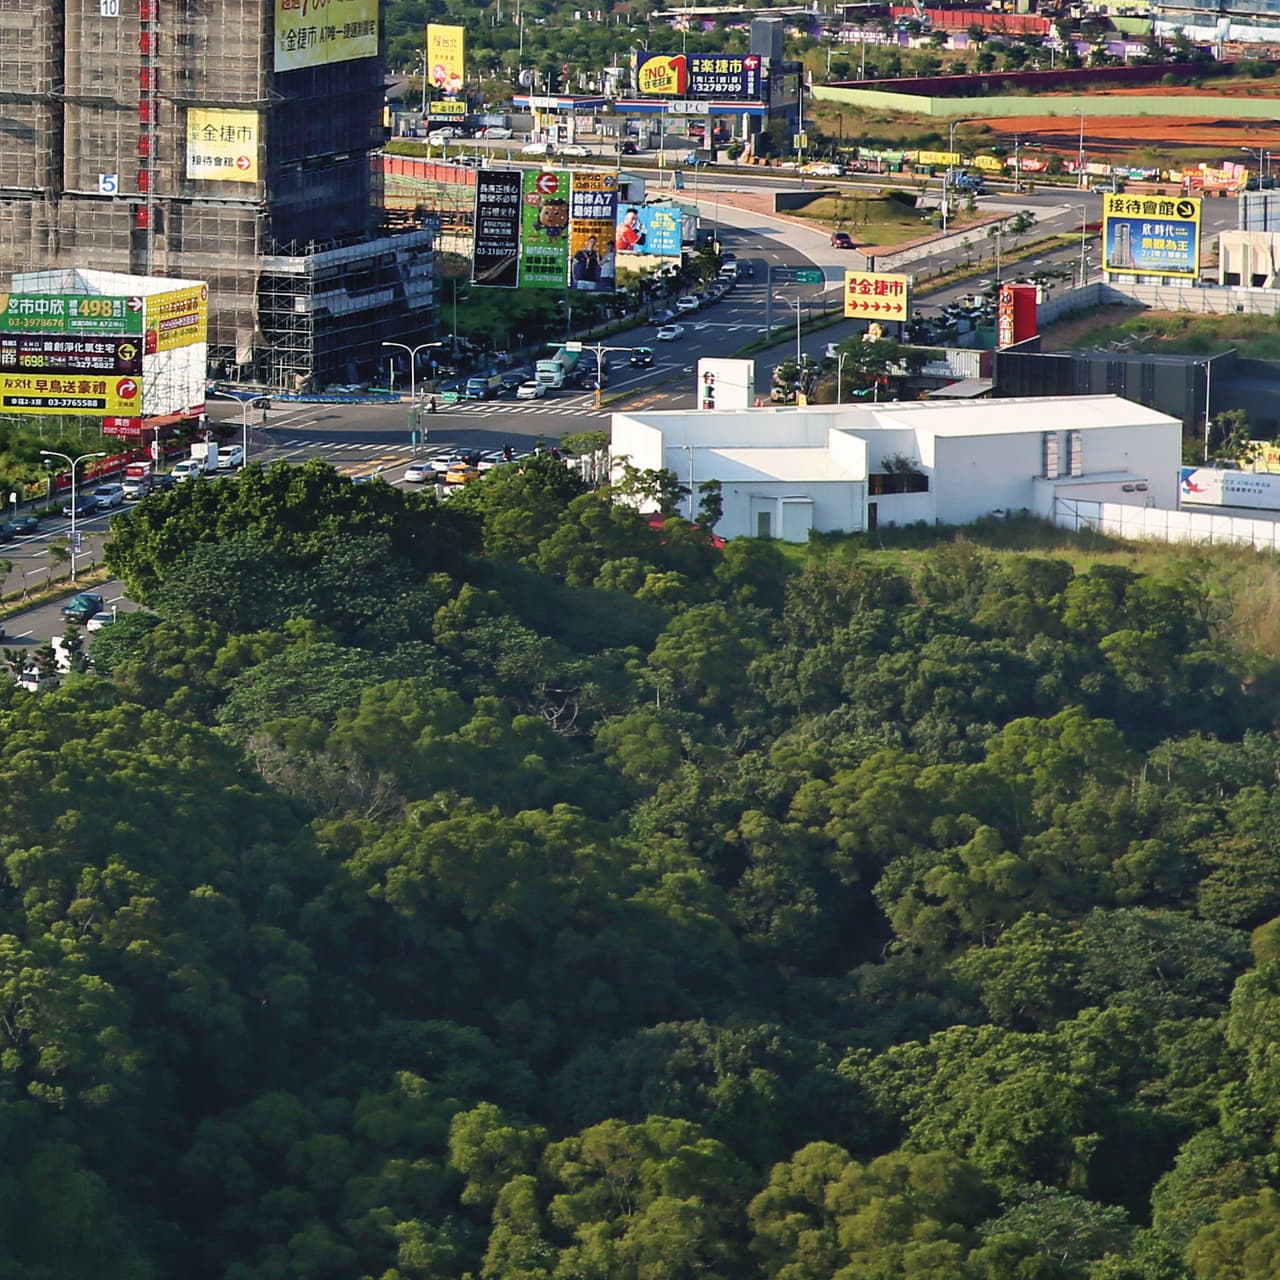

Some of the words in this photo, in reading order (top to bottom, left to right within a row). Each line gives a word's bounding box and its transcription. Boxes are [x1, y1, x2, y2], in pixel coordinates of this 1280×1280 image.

[102, 0, 117, 15] 10
[286, 25, 318, 51] 金捷市
[701, 59, 742, 73] 楽捷市
[673, 103, 703, 112] CPC
[202, 124, 252, 143] 金捷市
[101, 176, 115, 193] 5
[1109, 199, 1175, 216] 接待會館
[857, 278, 904, 297] 金捷市
[19, 298, 64, 315] 市中欣
[35, 380, 107, 395] 早鳥送豪禮
